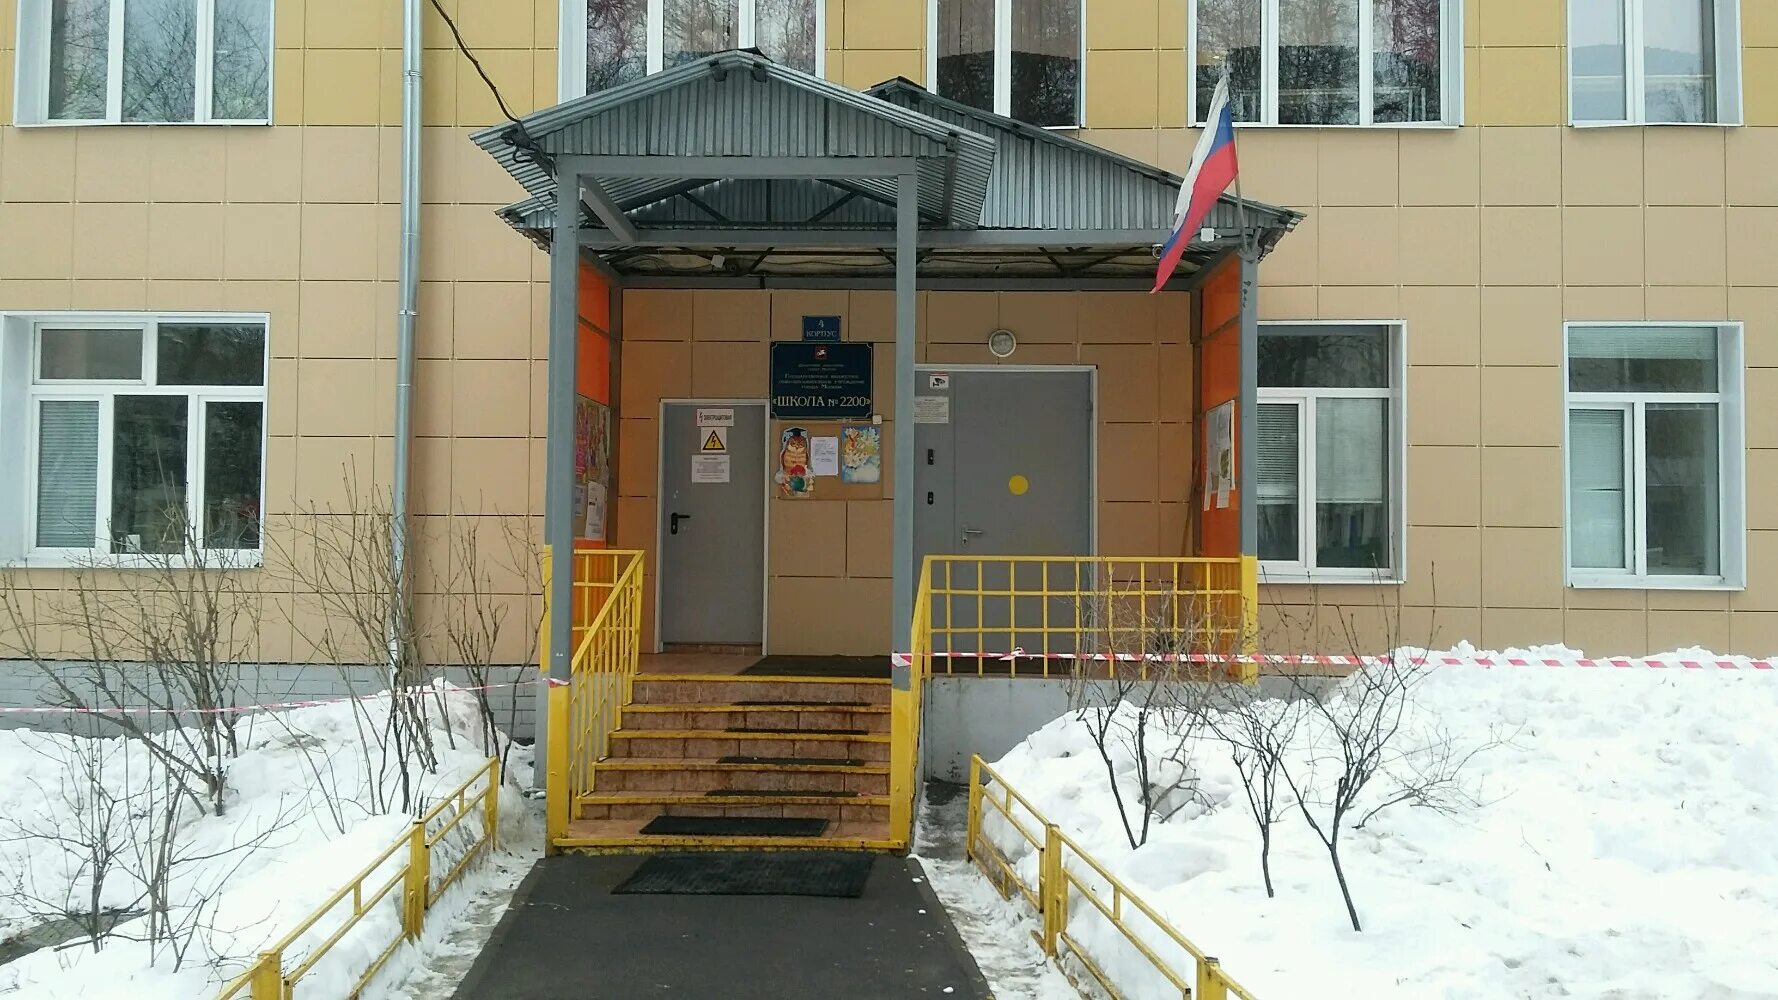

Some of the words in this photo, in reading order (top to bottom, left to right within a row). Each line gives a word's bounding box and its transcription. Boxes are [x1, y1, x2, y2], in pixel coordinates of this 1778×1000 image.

[818, 319, 825, 328] 4
[806, 330, 838, 338] КОРПУС
[772, 395, 825, 407] «ШКОЛА
[839, 395, 871, 407] 2200»
